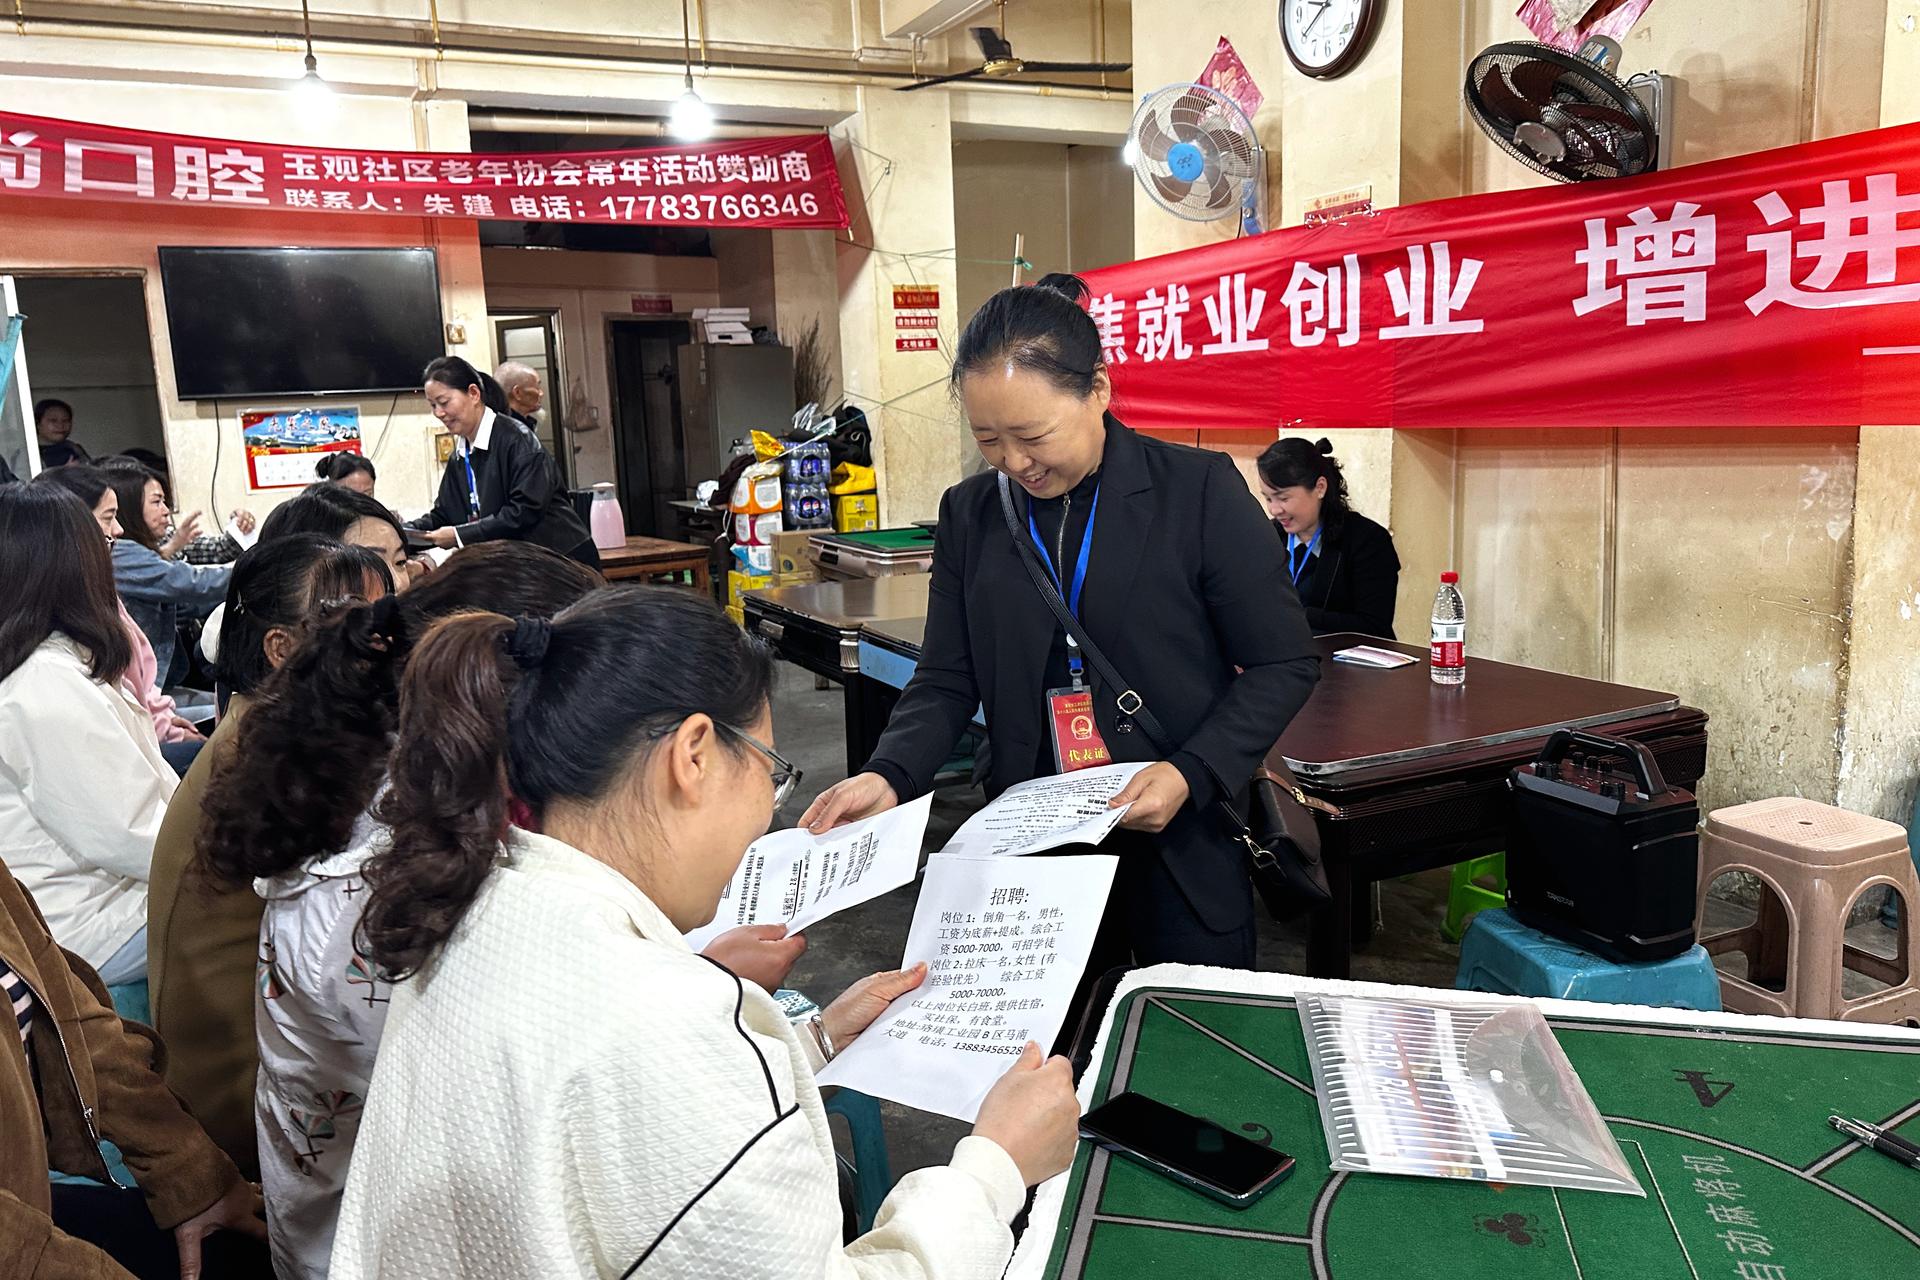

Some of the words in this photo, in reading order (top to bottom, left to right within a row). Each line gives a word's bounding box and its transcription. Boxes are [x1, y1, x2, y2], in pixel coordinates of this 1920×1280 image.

[1296, 6, 1303, 23] 9
[1311, 38, 1318, 57] 7
[1324, 39, 1332, 57] 6
[282, 150, 812, 188] 玉观社区老年协会常年活动赞助商
[1088, 241, 1484, 364] 焦就业创业
[1069, 747, 1105, 762] 代表证
[1000, 968, 1046, 983] 综合工资
[882, 1028, 908, 1041] 大道
[1672, 1069, 1736, 1107] 4
